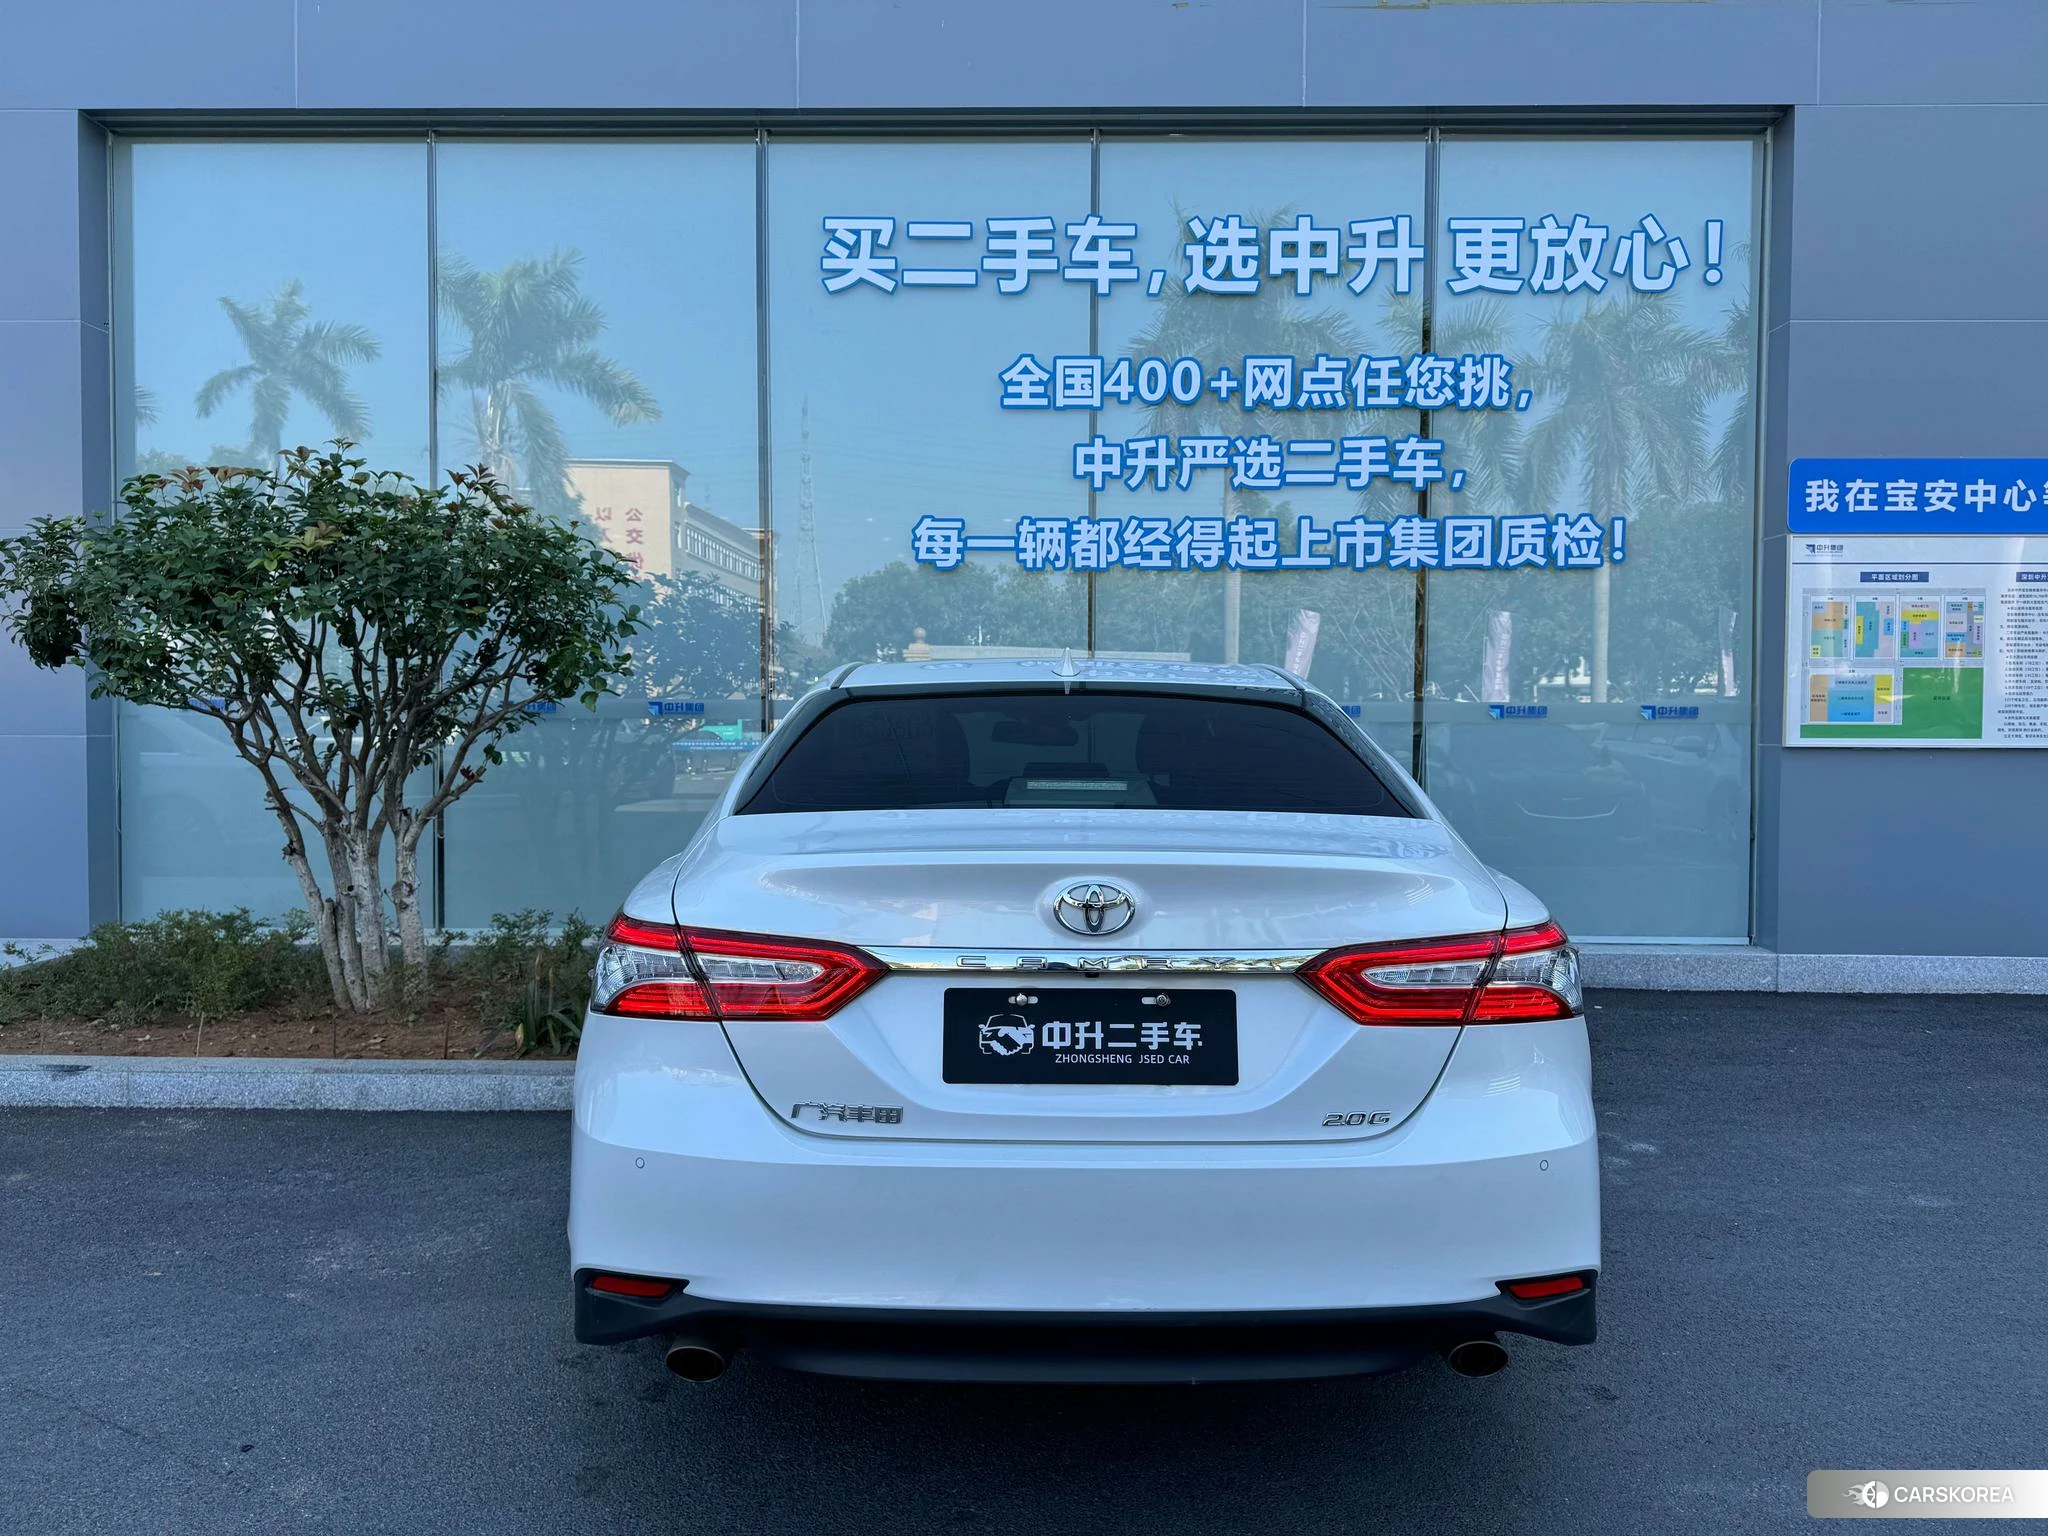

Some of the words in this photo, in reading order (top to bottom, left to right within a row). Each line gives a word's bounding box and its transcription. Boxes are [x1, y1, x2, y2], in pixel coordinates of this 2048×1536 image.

[1001, 354, 1532, 411] 全国400+网点任您挑，
[1073, 436, 1466, 490] 中升严选二手车，
[1805, 479, 2048, 512] 我在宝安中心
[911, 515, 1629, 572] 每一辆都经得起上市集团质检！
[1041, 1020, 1203, 1050] 中升二手车
[1055, 1053, 1132, 1064] ZHONGSHENG
[1168, 1054, 1190, 1064] CAR
